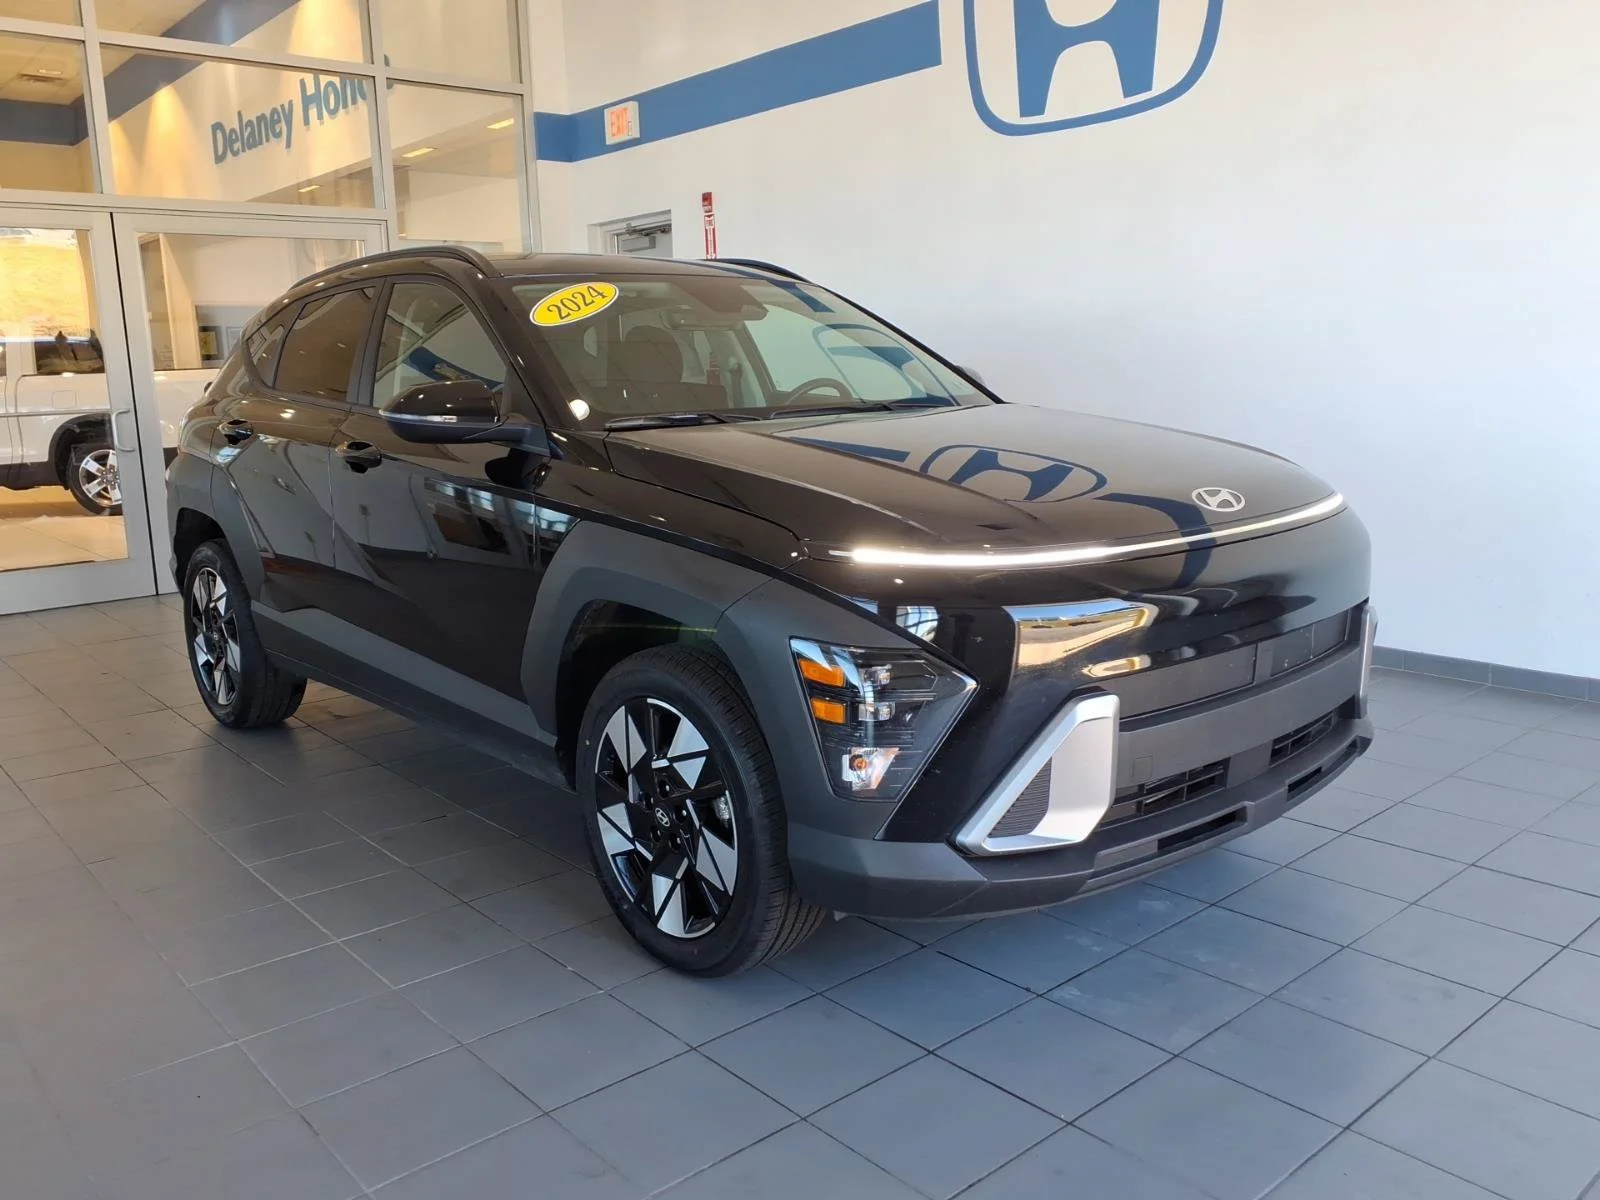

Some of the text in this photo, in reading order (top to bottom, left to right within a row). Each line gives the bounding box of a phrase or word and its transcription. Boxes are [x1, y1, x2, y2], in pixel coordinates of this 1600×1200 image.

[211, 66, 392, 164] Delaney Hon
[611, 107, 628, 137] EXIT
[547, 285, 607, 320] 2024
